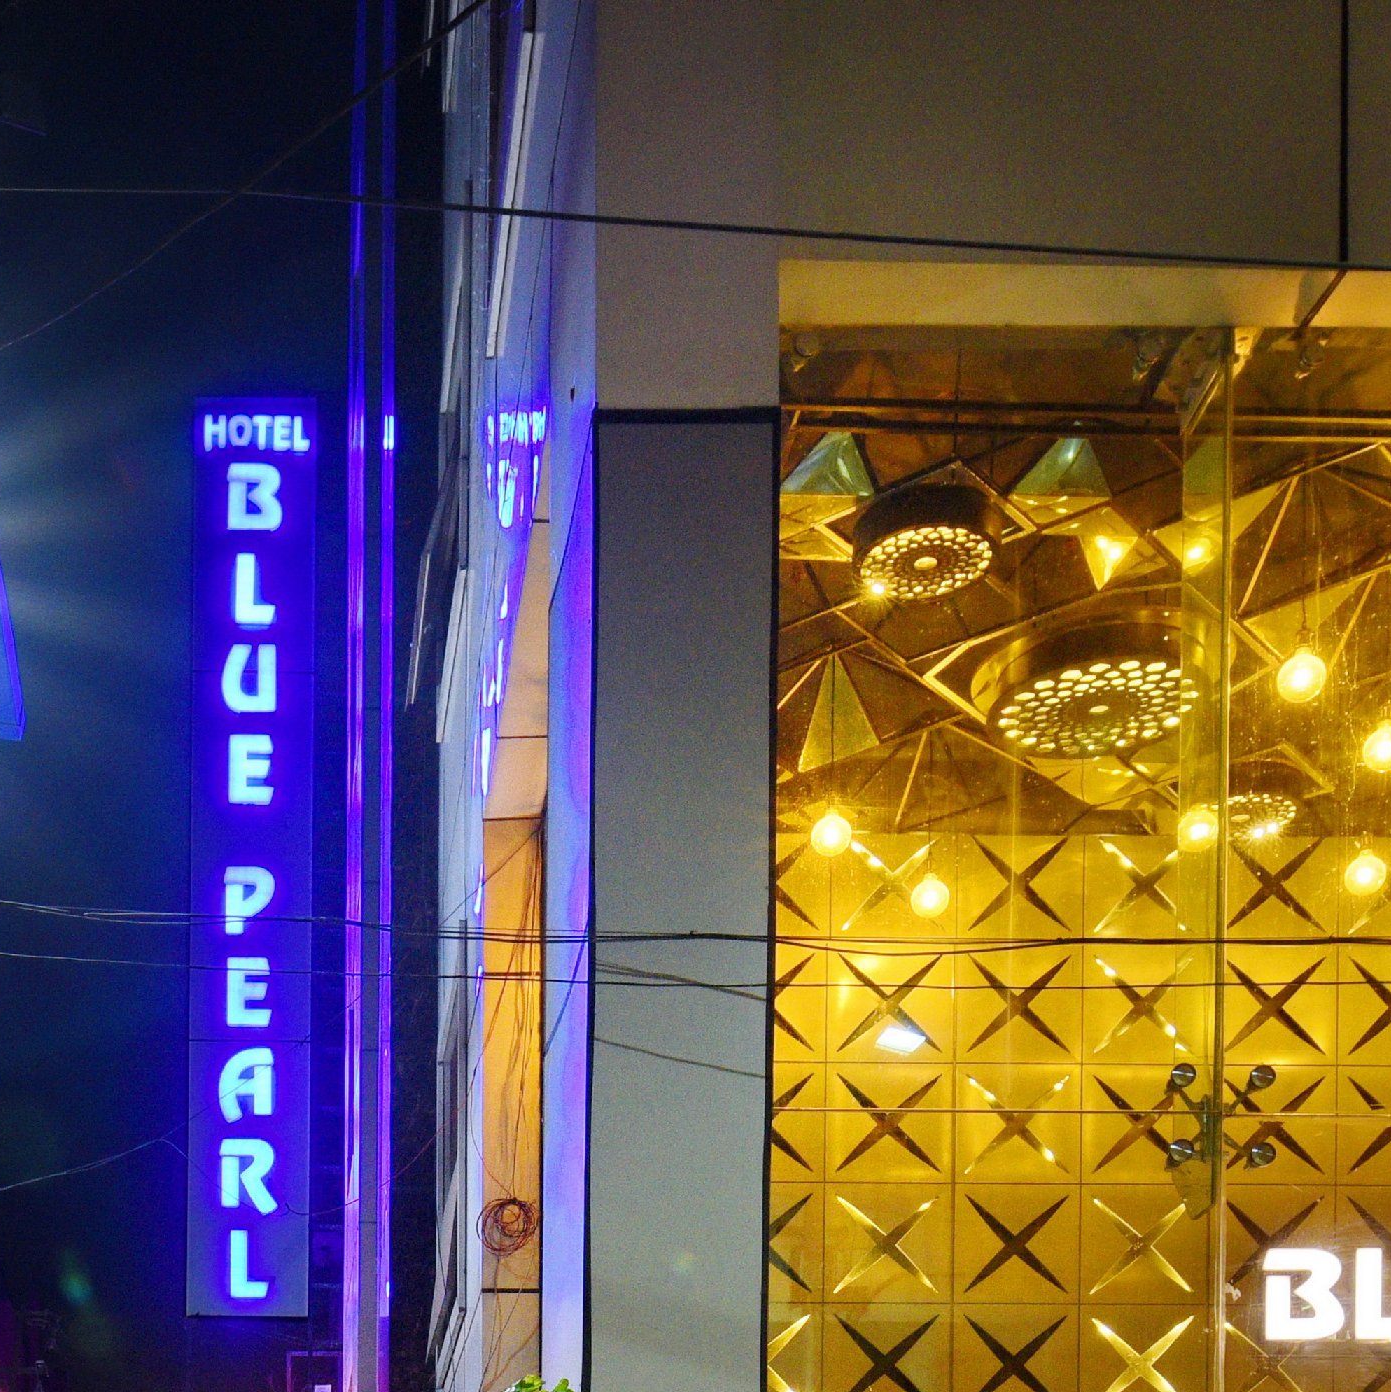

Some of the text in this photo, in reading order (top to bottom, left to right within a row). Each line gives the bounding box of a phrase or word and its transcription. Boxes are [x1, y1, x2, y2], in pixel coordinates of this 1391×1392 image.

[204, 414, 310, 453] HOTEL
[218, 462, 283, 1299] BLUE PEARL
